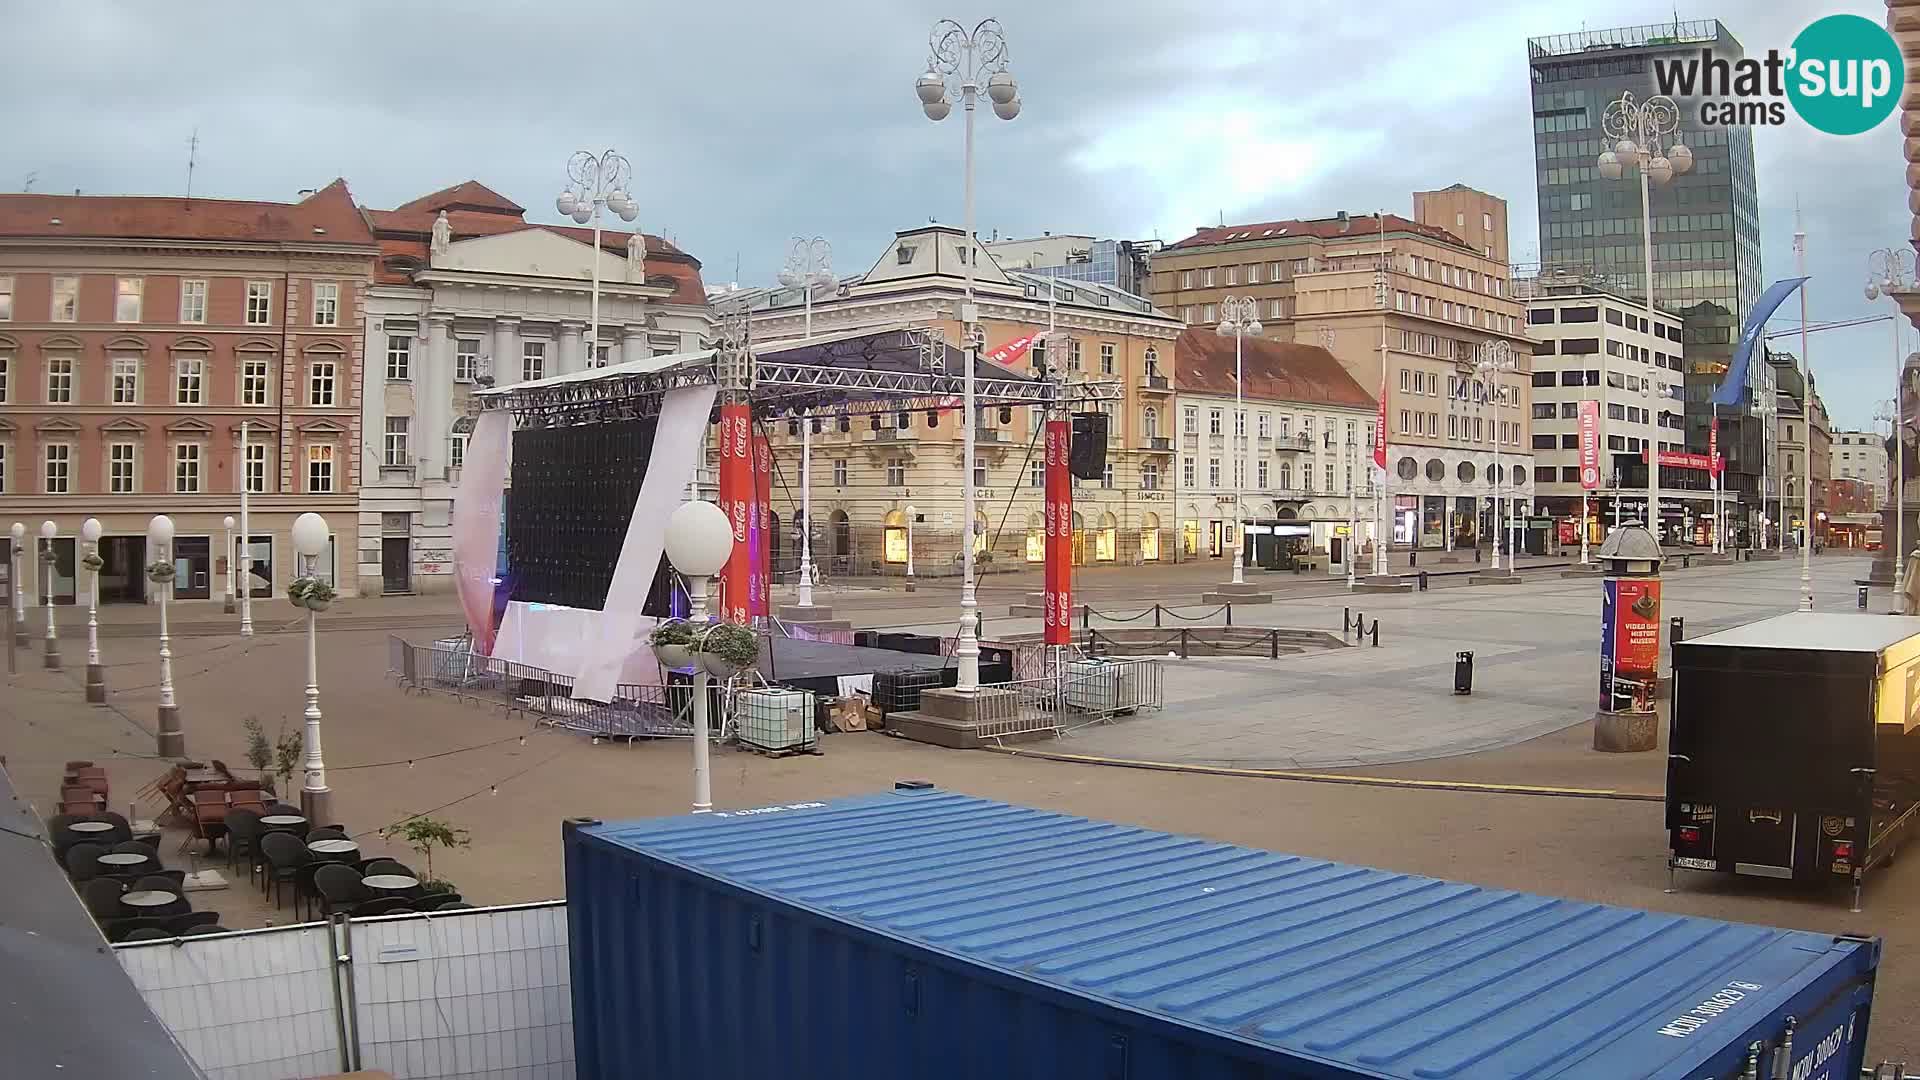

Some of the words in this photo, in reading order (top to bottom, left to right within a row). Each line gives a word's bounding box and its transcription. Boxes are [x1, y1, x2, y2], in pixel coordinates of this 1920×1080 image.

[1657, 1014, 1708, 1038] MCDU
[1690, 988, 1746, 1017] 300629
[1814, 1024, 1844, 1070] 300629
